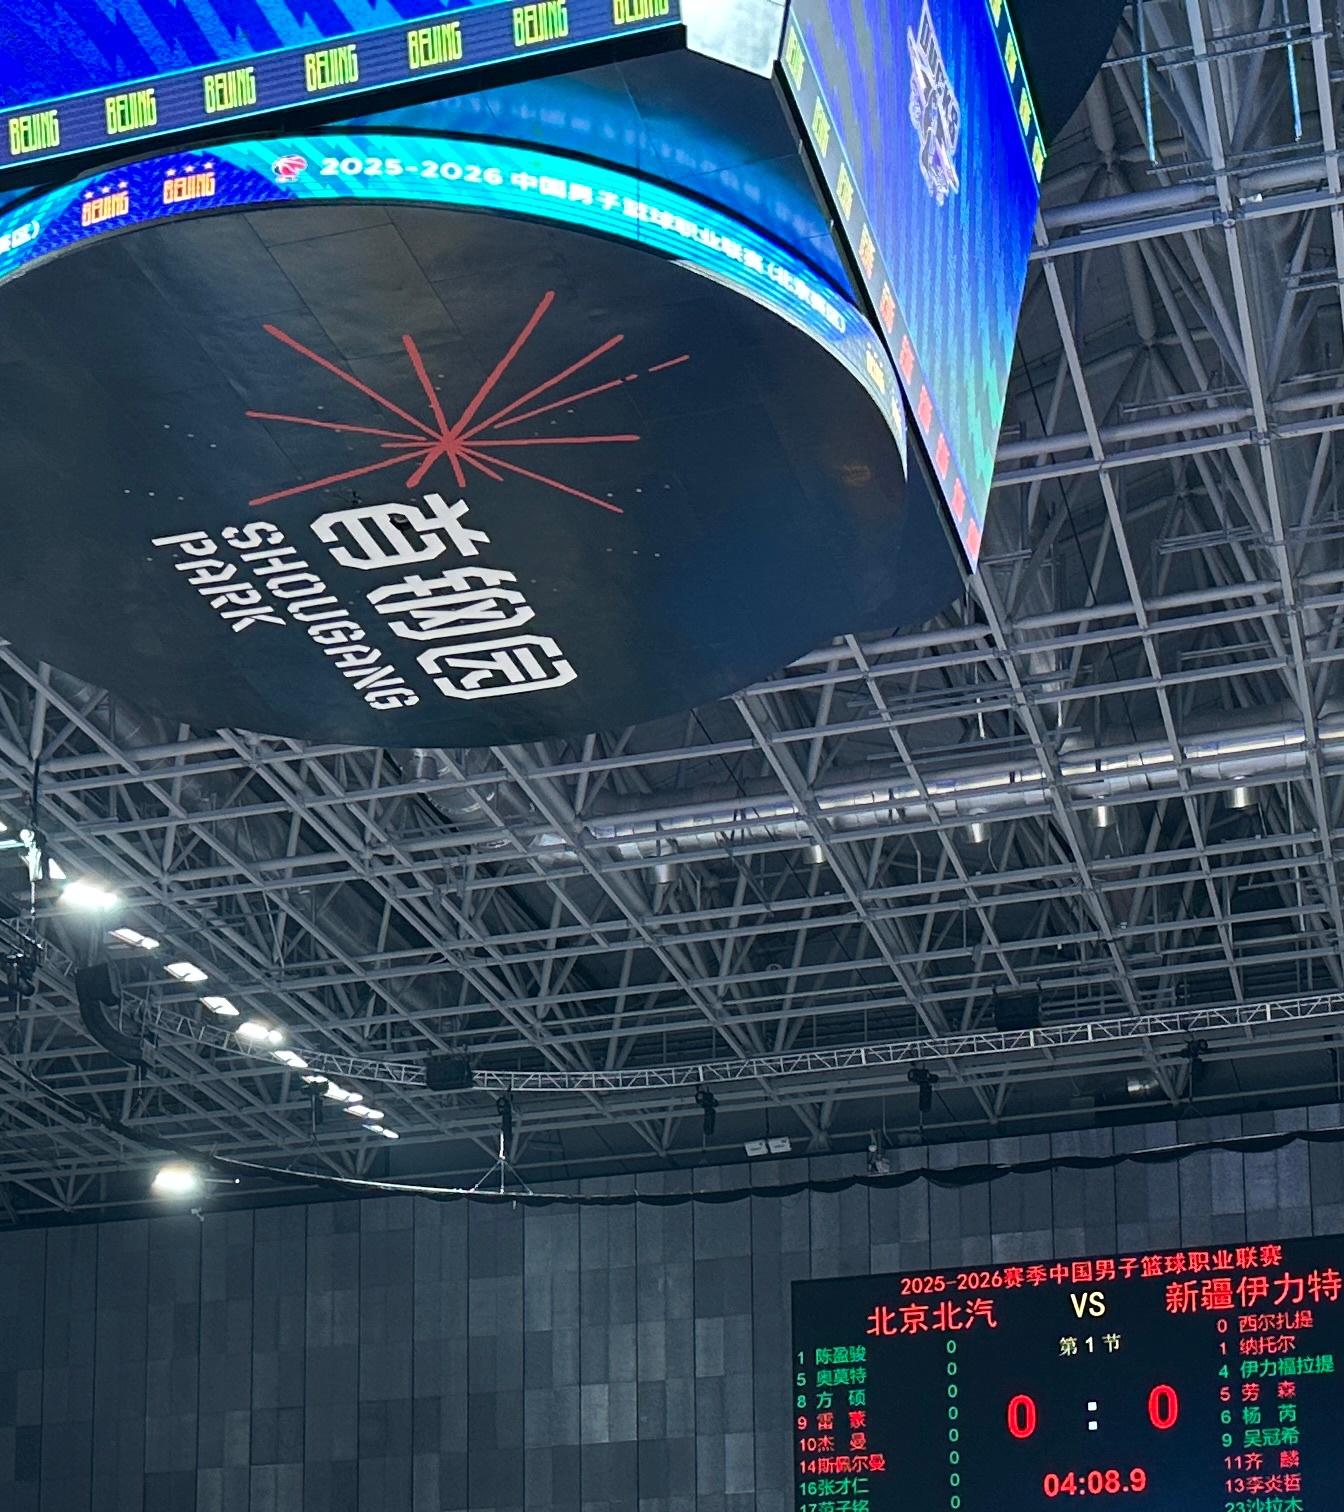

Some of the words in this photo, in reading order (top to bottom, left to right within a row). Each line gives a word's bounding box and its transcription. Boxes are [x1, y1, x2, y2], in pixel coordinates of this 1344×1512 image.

[513, 0, 568, 48] BEIJING
[408, 22, 462, 70] BEIJING
[305, 44, 358, 92] BEIJING
[204, 67, 256, 114] BEIJING
[105, 89, 157, 135] BEIJING
[10, 109, 60, 155] BEIJING
[319, 157, 502, 187] 2025-2026
[163, 172, 215, 205] BEIJING
[82, 189, 128, 226] BEIJING
[151, 530, 286, 633] PARK
[221, 520, 420, 711] SHOUGANG
[900, 1244, 1283, 1297] 2025-2026赛季中国男子篮球职业联赛
[866, 1298, 997, 1336] 北京北汽
[1070, 1291, 1106, 1318] VS
[1165, 1267, 1342, 1314] 新疆伊力特
[1216, 1318, 1228, 1333] 0
[797, 1351, 805, 1365] 1
[946, 1340, 957, 1354] 0
[1219, 1341, 1226, 1355] 1
[796, 1372, 806, 1387] 5
[947, 1362, 957, 1376] 0
[1218, 1364, 1229, 1379] 4
[796, 1395, 807, 1409] 8
[947, 1384, 958, 1398] 0
[1220, 1386, 1231, 1401] 5
[797, 1416, 807, 1430] 9
[948, 1406, 958, 1420] 0
[1007, 1394, 1037, 1439] 0
[1148, 1384, 1179, 1430] 0
[1220, 1409, 1232, 1424] 6
[949, 1428, 959, 1442] 0
[1221, 1433, 1232, 1448] 9
[949, 1450, 960, 1465] 0
[950, 1473, 960, 1487] 0
[1043, 1467, 1147, 1498] 04:08.9
[950, 1495, 961, 1509] 0
